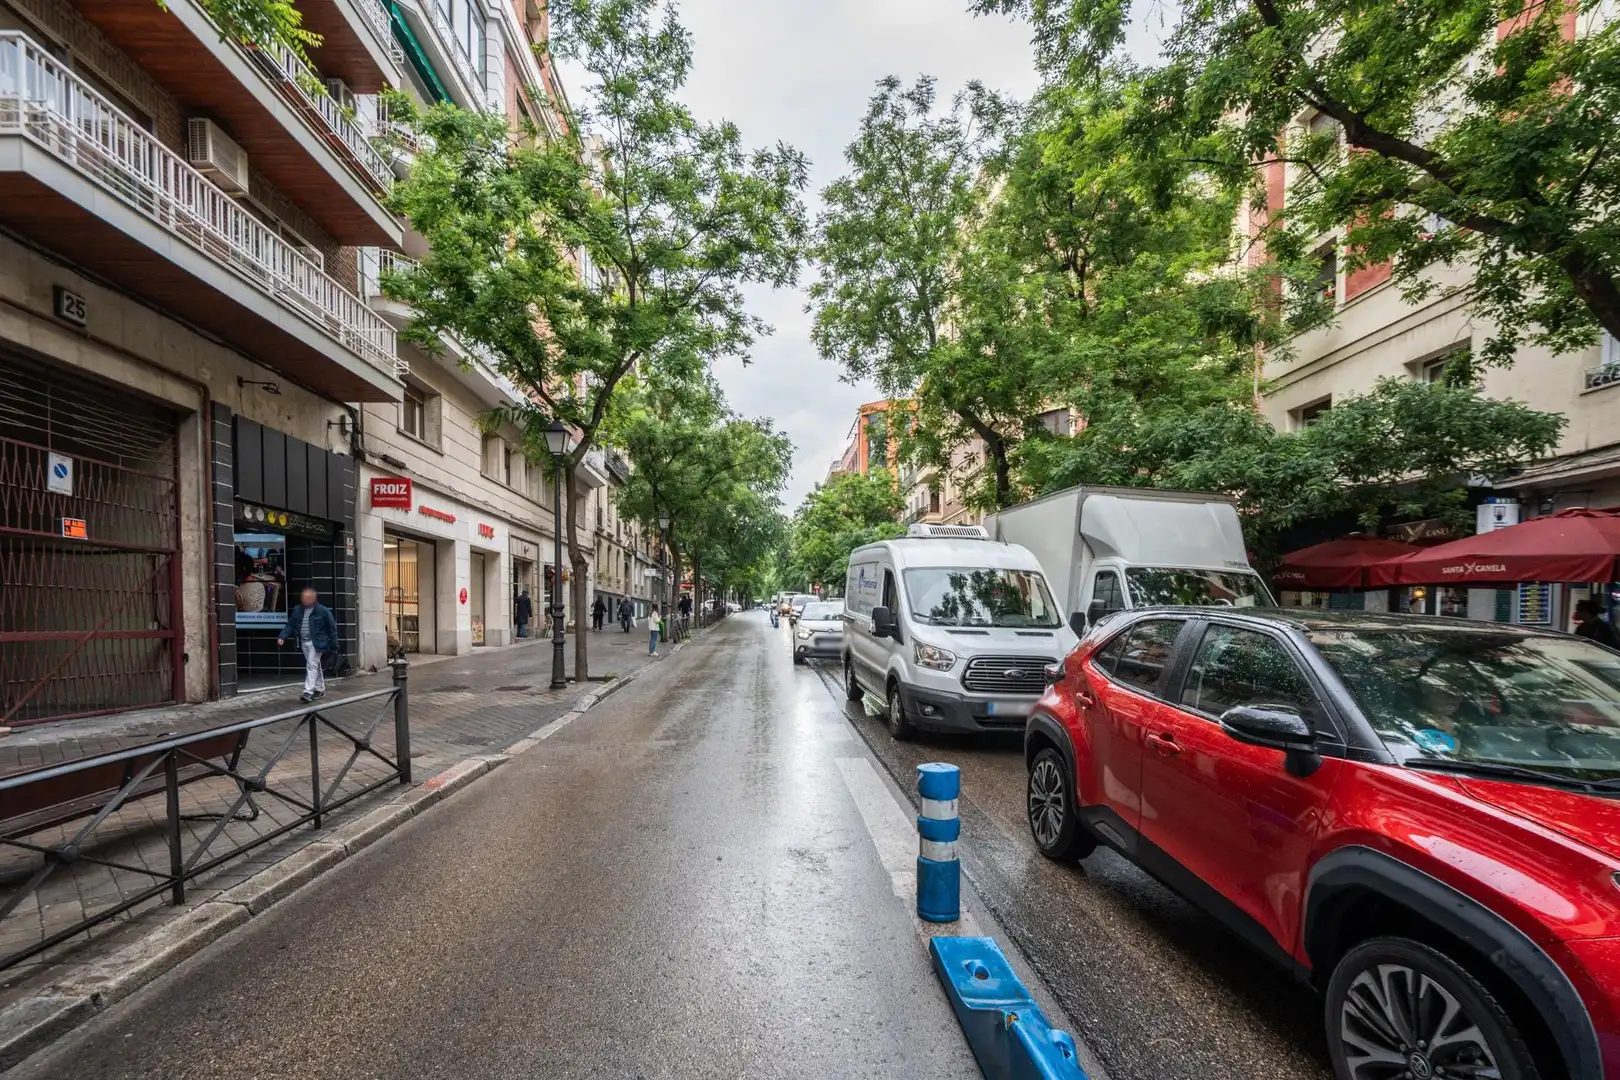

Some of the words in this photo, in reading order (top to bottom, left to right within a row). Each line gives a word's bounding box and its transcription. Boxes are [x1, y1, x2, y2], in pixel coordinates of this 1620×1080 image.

[65, 294, 86, 319] 25
[374, 483, 407, 495] FROIZ
[1441, 566, 1464, 574] SANTA
[1475, 564, 1507, 573] CANELA
